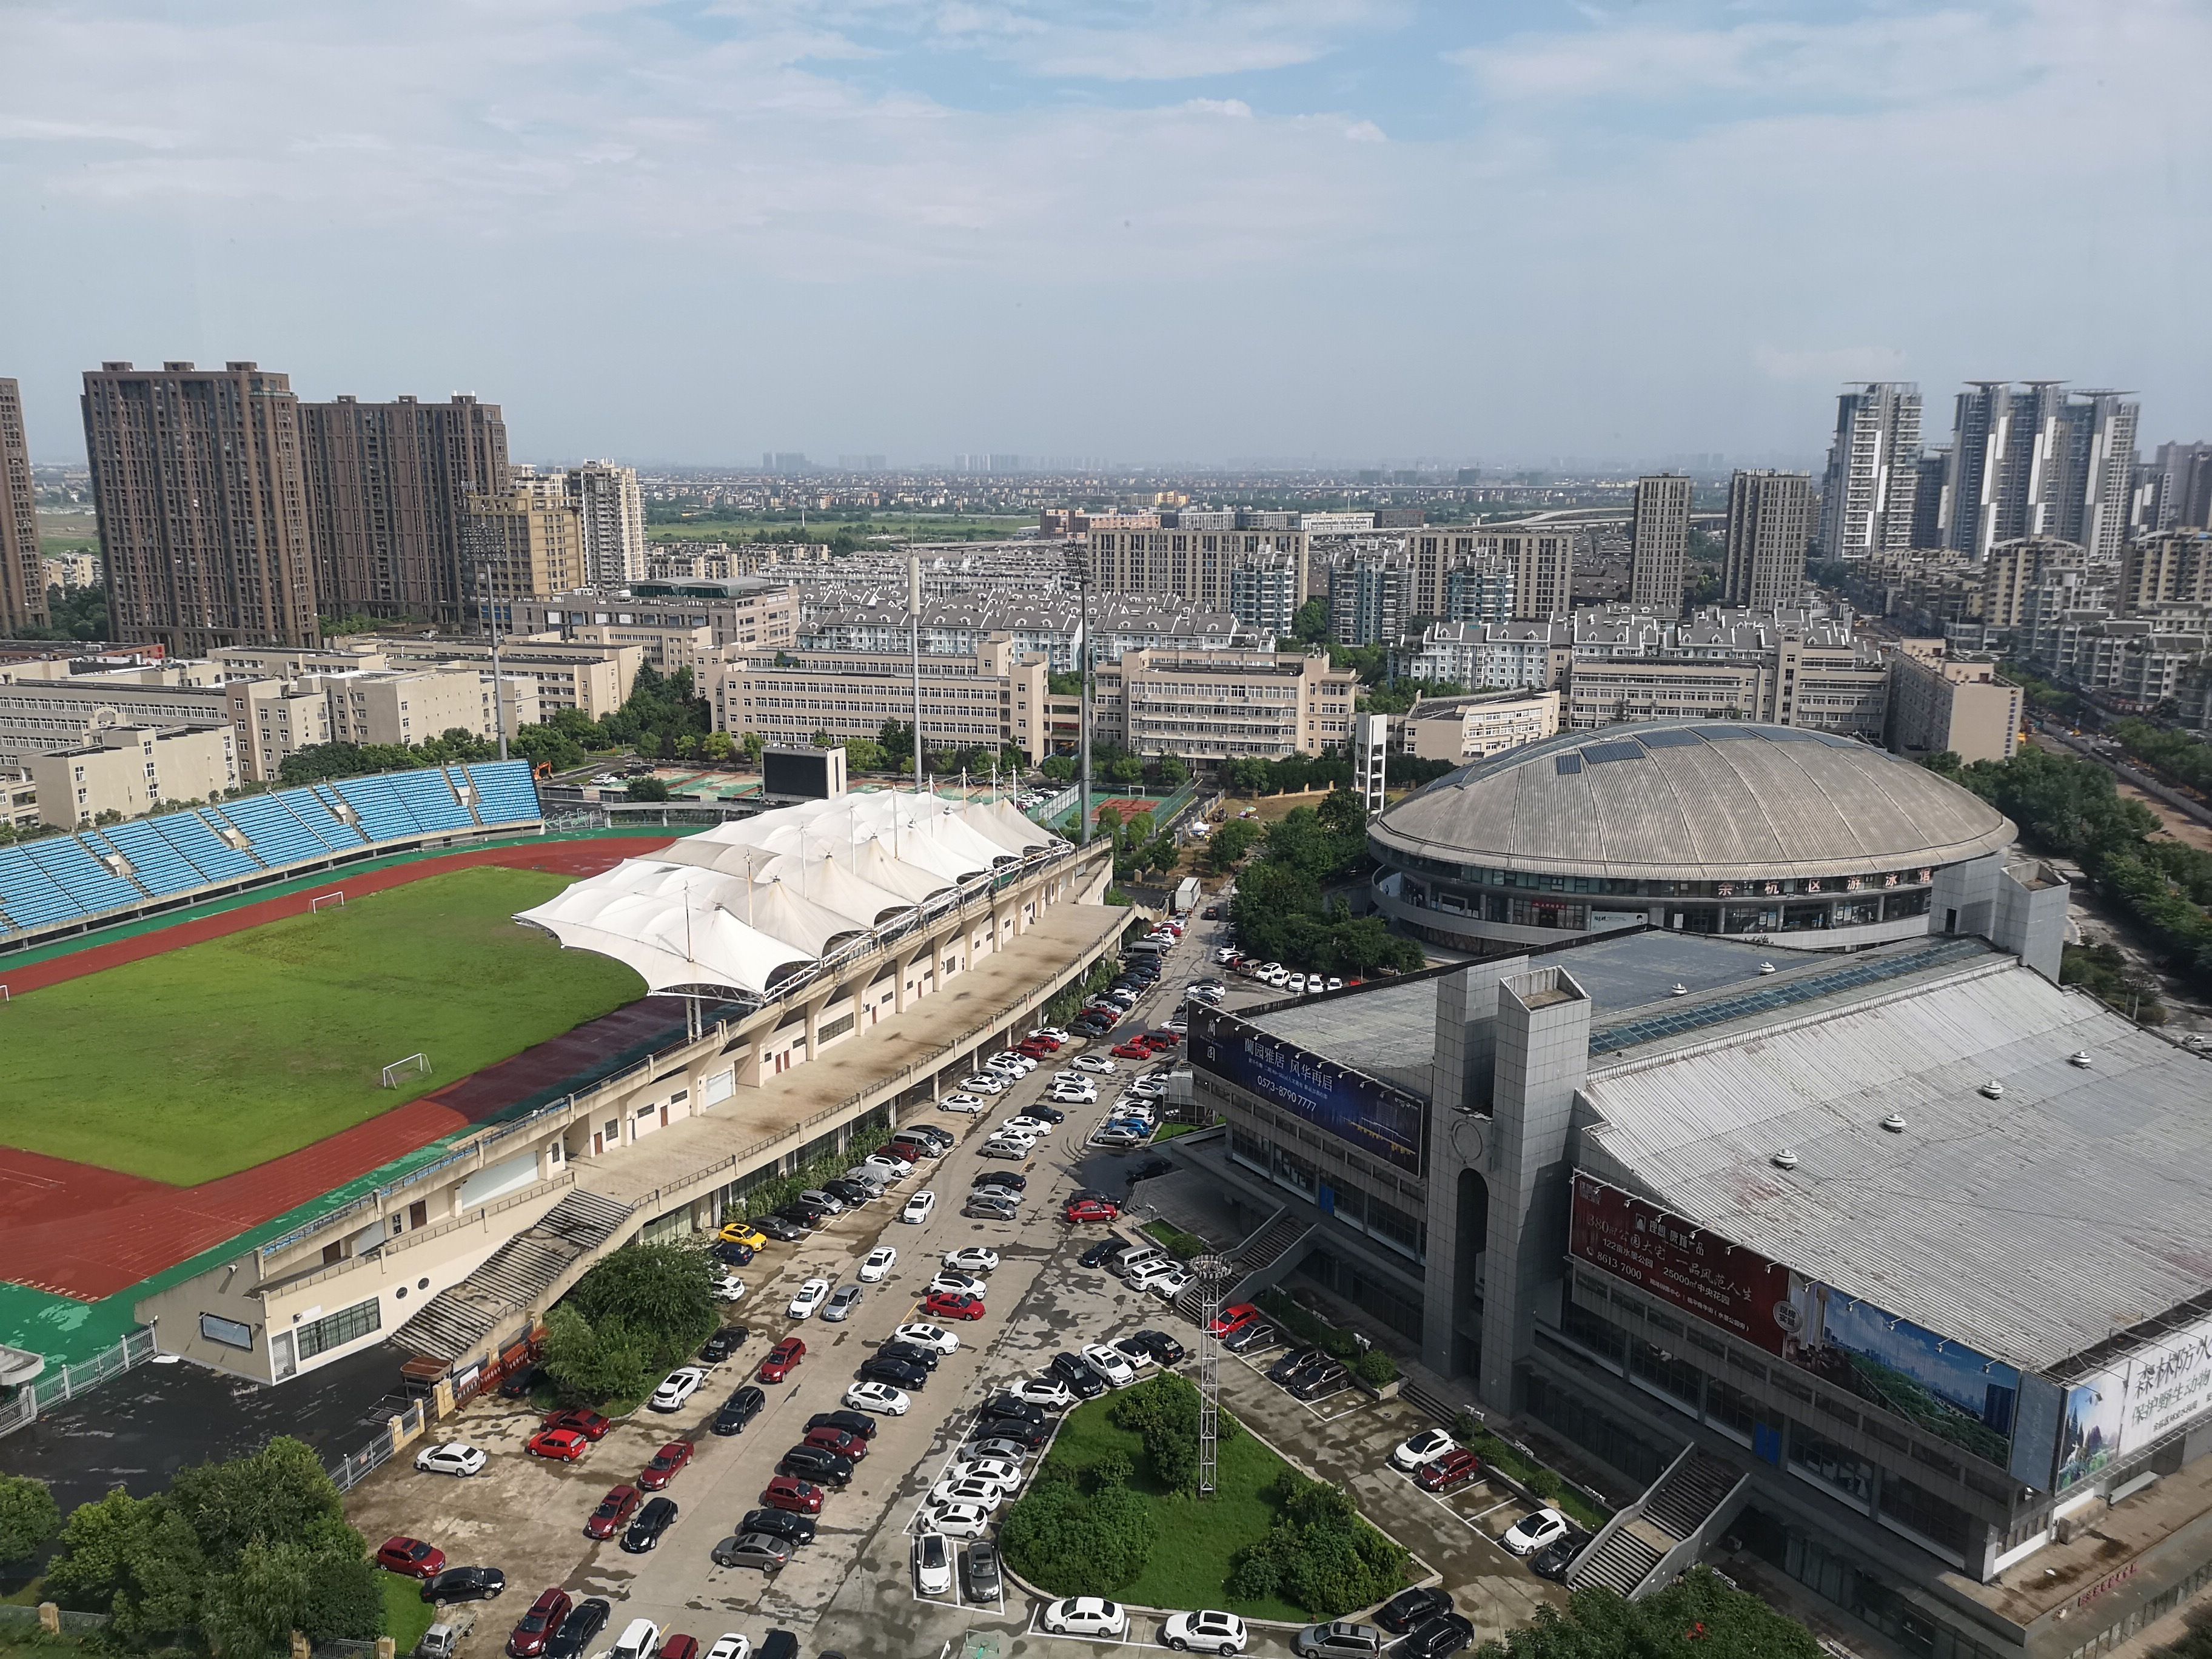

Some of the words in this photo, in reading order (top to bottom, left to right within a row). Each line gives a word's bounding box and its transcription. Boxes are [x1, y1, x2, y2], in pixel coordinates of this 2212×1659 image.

[1718, 868, 1932, 896] 余杭区游泳馆
[1290, 1059, 1333, 1092] 风华再启
[1649, 1220, 1666, 1238] 理想
[1597, 1251, 1618, 1268] 8613
[1620, 1262, 1642, 1280] 7000
[1603, 1238, 1654, 1269] 122亩水景公园
[1663, 1267, 1730, 1305] 25000㎡中央花园
[1676, 1258, 1752, 1302] 一品风范人生
[2134, 1335, 2212, 1399] 森林防火
[2132, 1368, 2211, 1427] 保护野生动物
